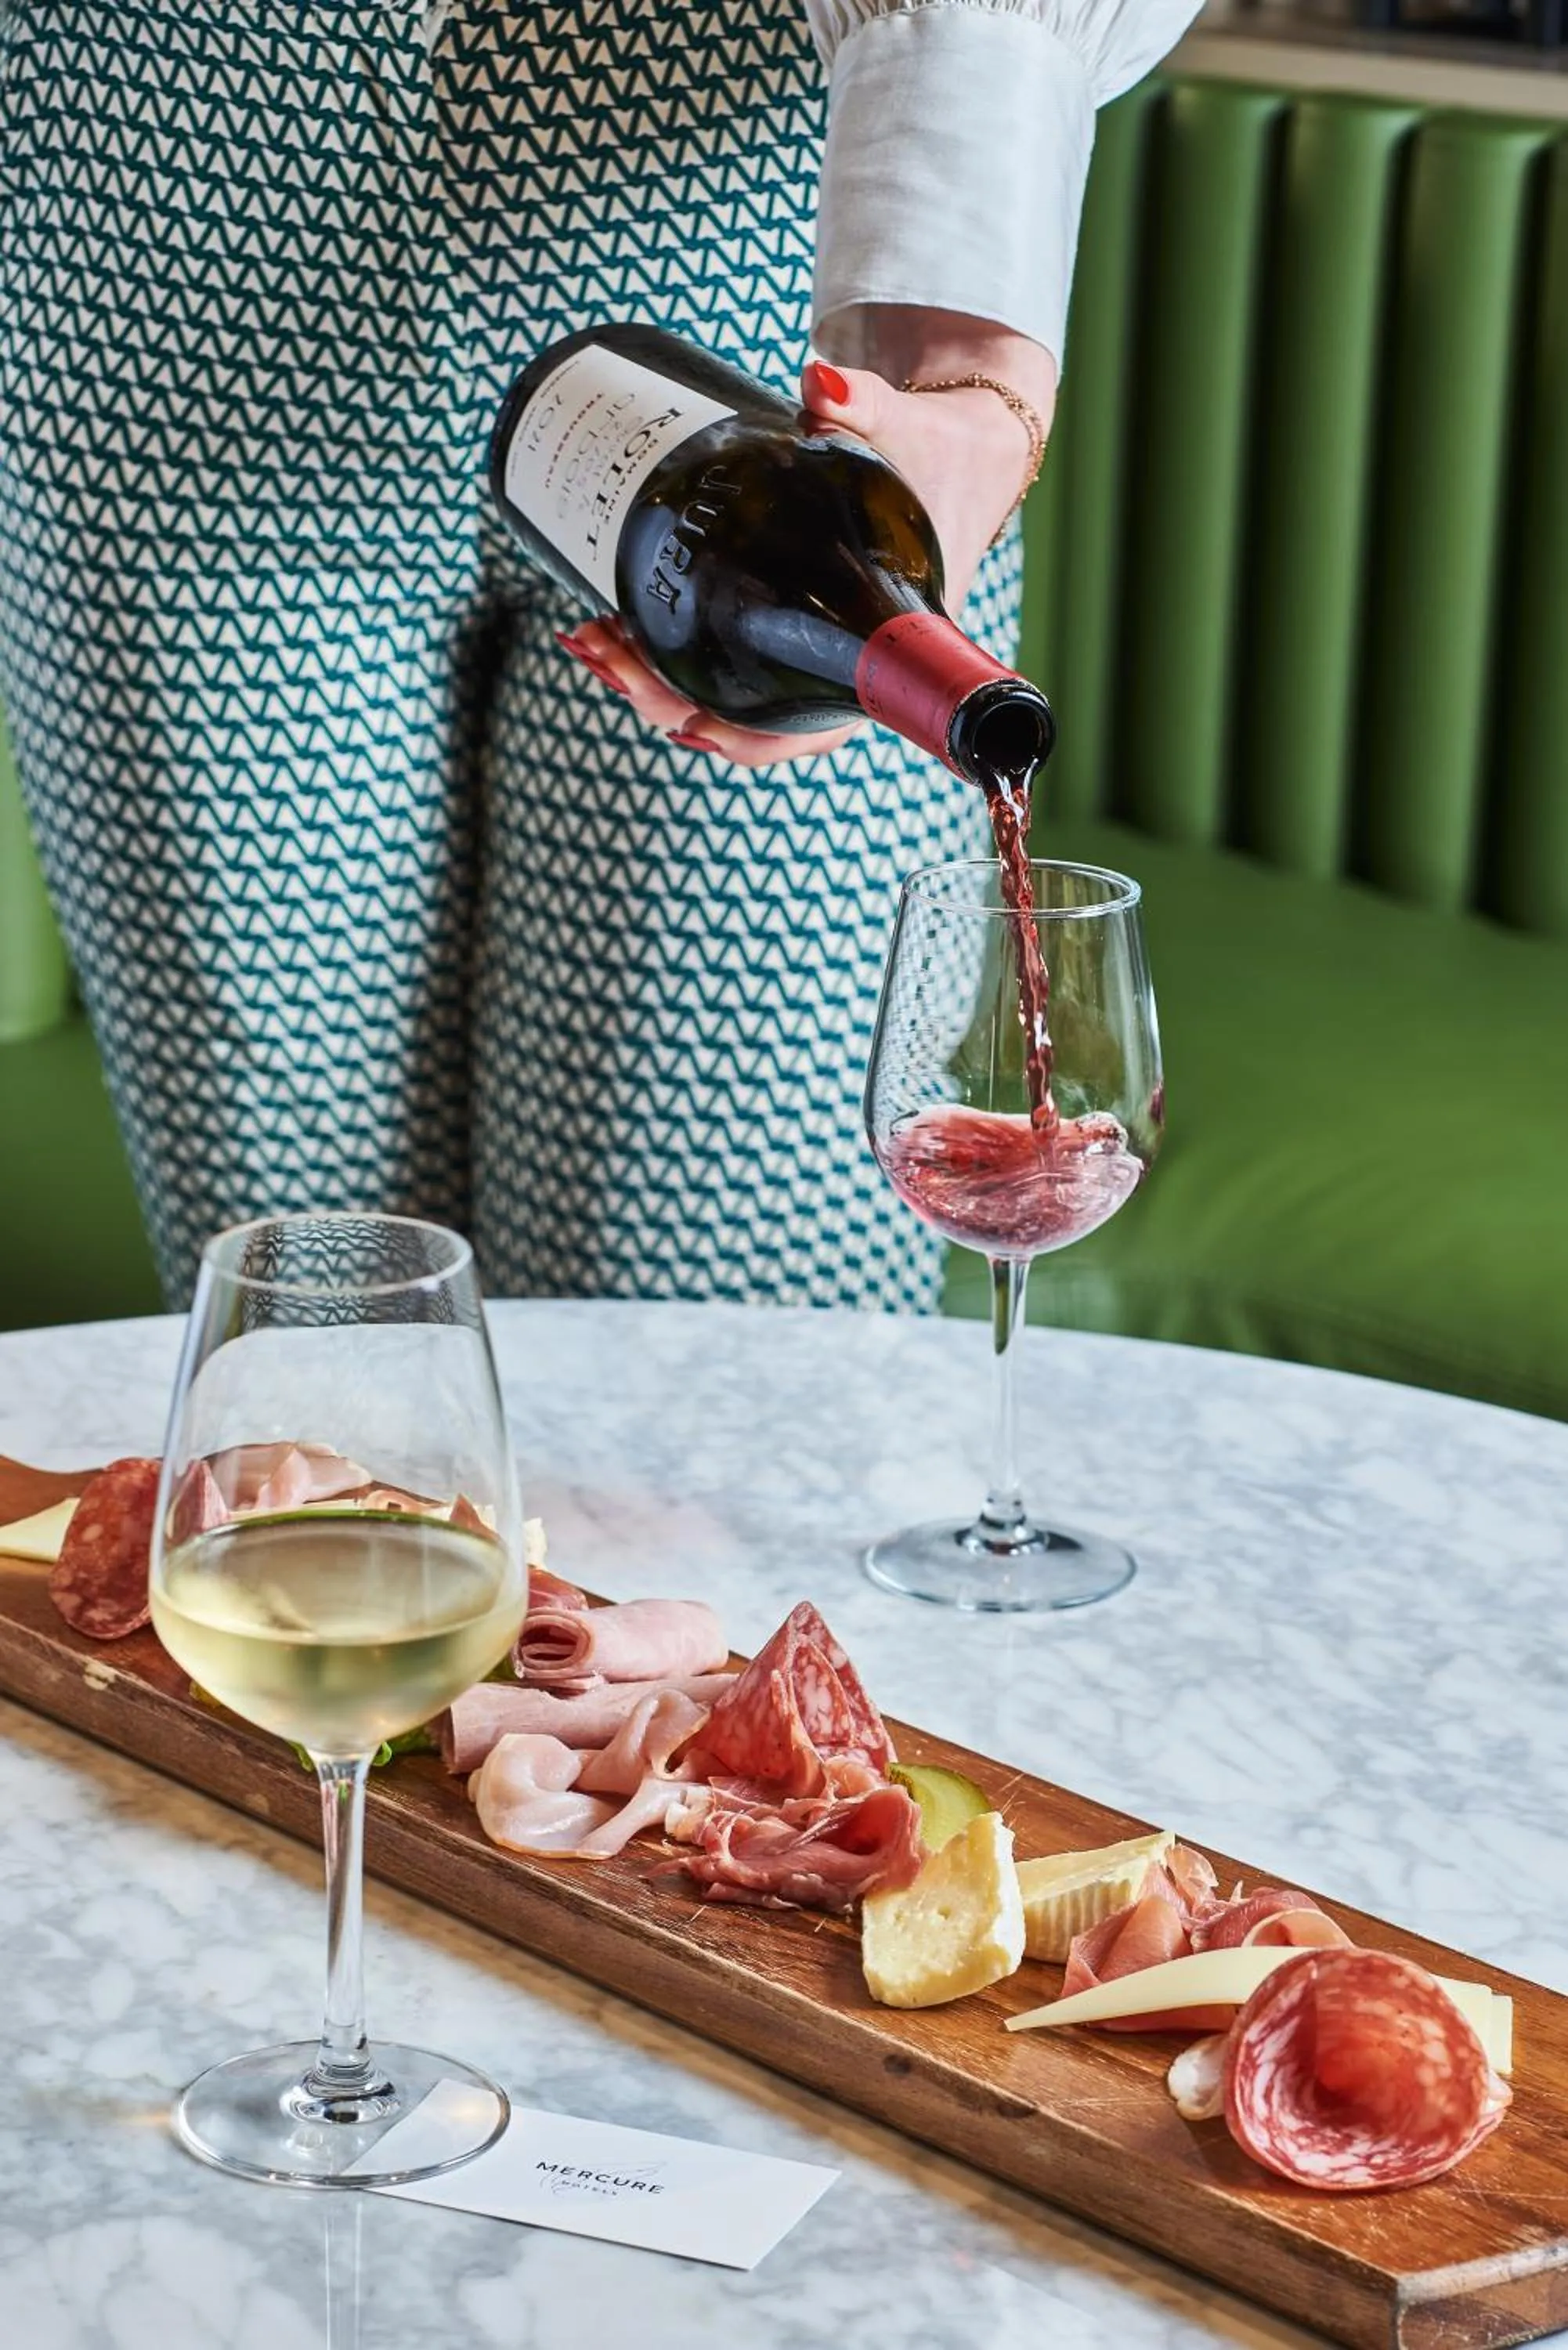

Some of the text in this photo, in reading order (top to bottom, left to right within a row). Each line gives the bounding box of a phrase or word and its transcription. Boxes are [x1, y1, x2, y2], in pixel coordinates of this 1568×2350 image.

[527, 393, 563, 452] 2021
[545, 392, 605, 489] TROUSSEAU
[587, 407, 683, 562] ROLET
[603, 439, 659, 525] DOMAINE
[647, 465, 742, 614] JURA
[536, 2162, 664, 2193] MERCURE
